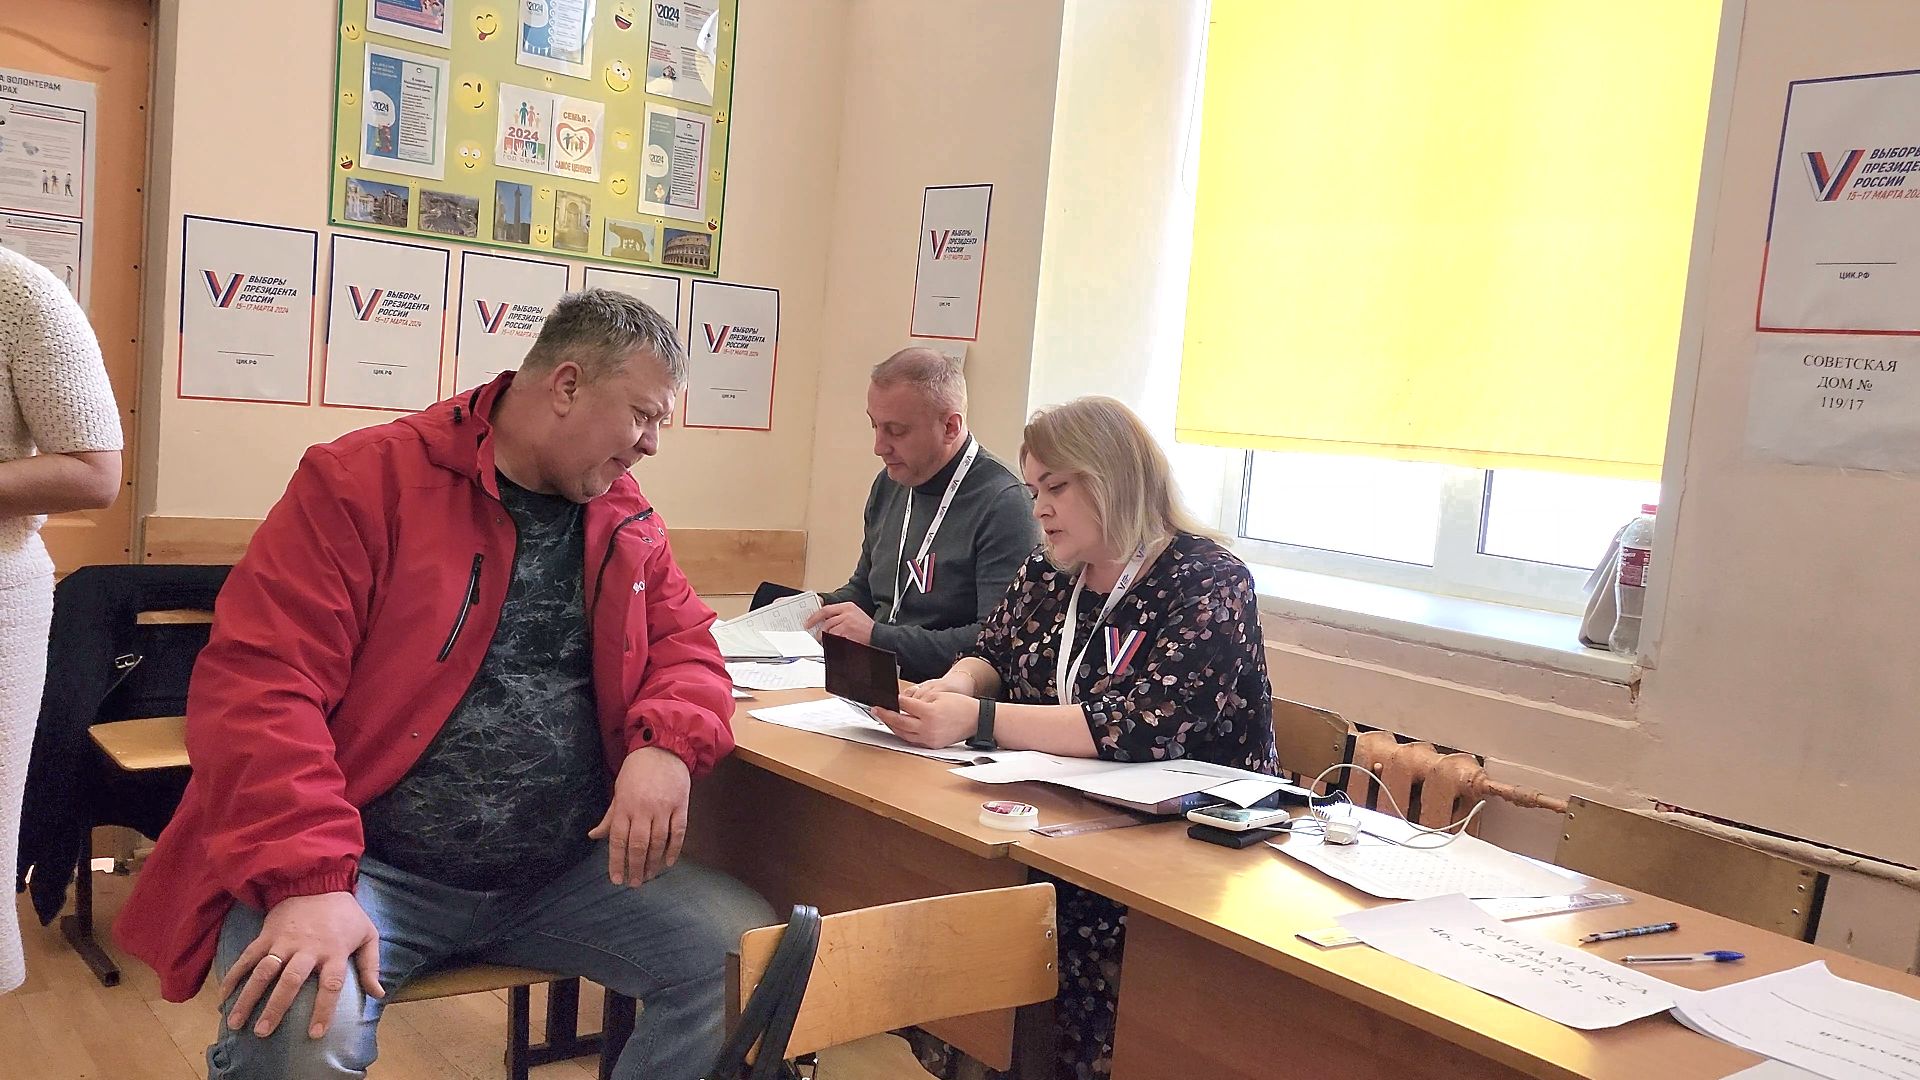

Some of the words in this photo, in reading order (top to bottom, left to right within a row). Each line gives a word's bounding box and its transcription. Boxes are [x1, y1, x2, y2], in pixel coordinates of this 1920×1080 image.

[657, 4, 680, 22] 2024
[6, 75, 61, 91] ВОЛОНТЕРАМ
[372, 100, 389, 112] 2024
[563, 111, 587, 123] СЕМЬЯ
[508, 126, 539, 141] 2024
[649, 153, 664, 163] 2024
[1861, 160, 1920, 174] ПРЕЗИДЕ
[1853, 176, 1906, 188] РОССИИ
[1871, 189, 1904, 200] МАРТА
[248, 275, 287, 286] ВЫБОРЫ
[1839, 272, 1870, 280] ЦИК.РФ
[243, 285, 297, 297] ПРЕЗИДЕНТА
[386, 290, 421, 300] ВЫБОРЫ
[239, 294, 274, 304] РОССИИ
[252, 305, 273, 313] МАРТА
[274, 306, 289, 314] 2024
[382, 299, 430, 311] ПРЕЗИДЕНТА
[512, 304, 543, 314] ВЫБОРЫ
[377, 308, 409, 318] РОССИИ
[508, 313, 547, 323] ПРЕЗИДЕН
[504, 321, 533, 330] РОССИИ
[732, 326, 759, 334] ВЫБОРЫ
[729, 334, 766, 343] ПРЕЗИДЕНТА
[725, 341, 750, 349] РОССИИ
[1803, 354, 1898, 373] СОВЕТСКАЯ
[1817, 376, 1853, 389] ДОМ
[1856, 379, 1873, 391] №
[1822, 396, 1864, 410] 119/17
[1473, 926, 1544, 956] КАРЛА
[1549, 956, 1647, 994] МАРКСА
